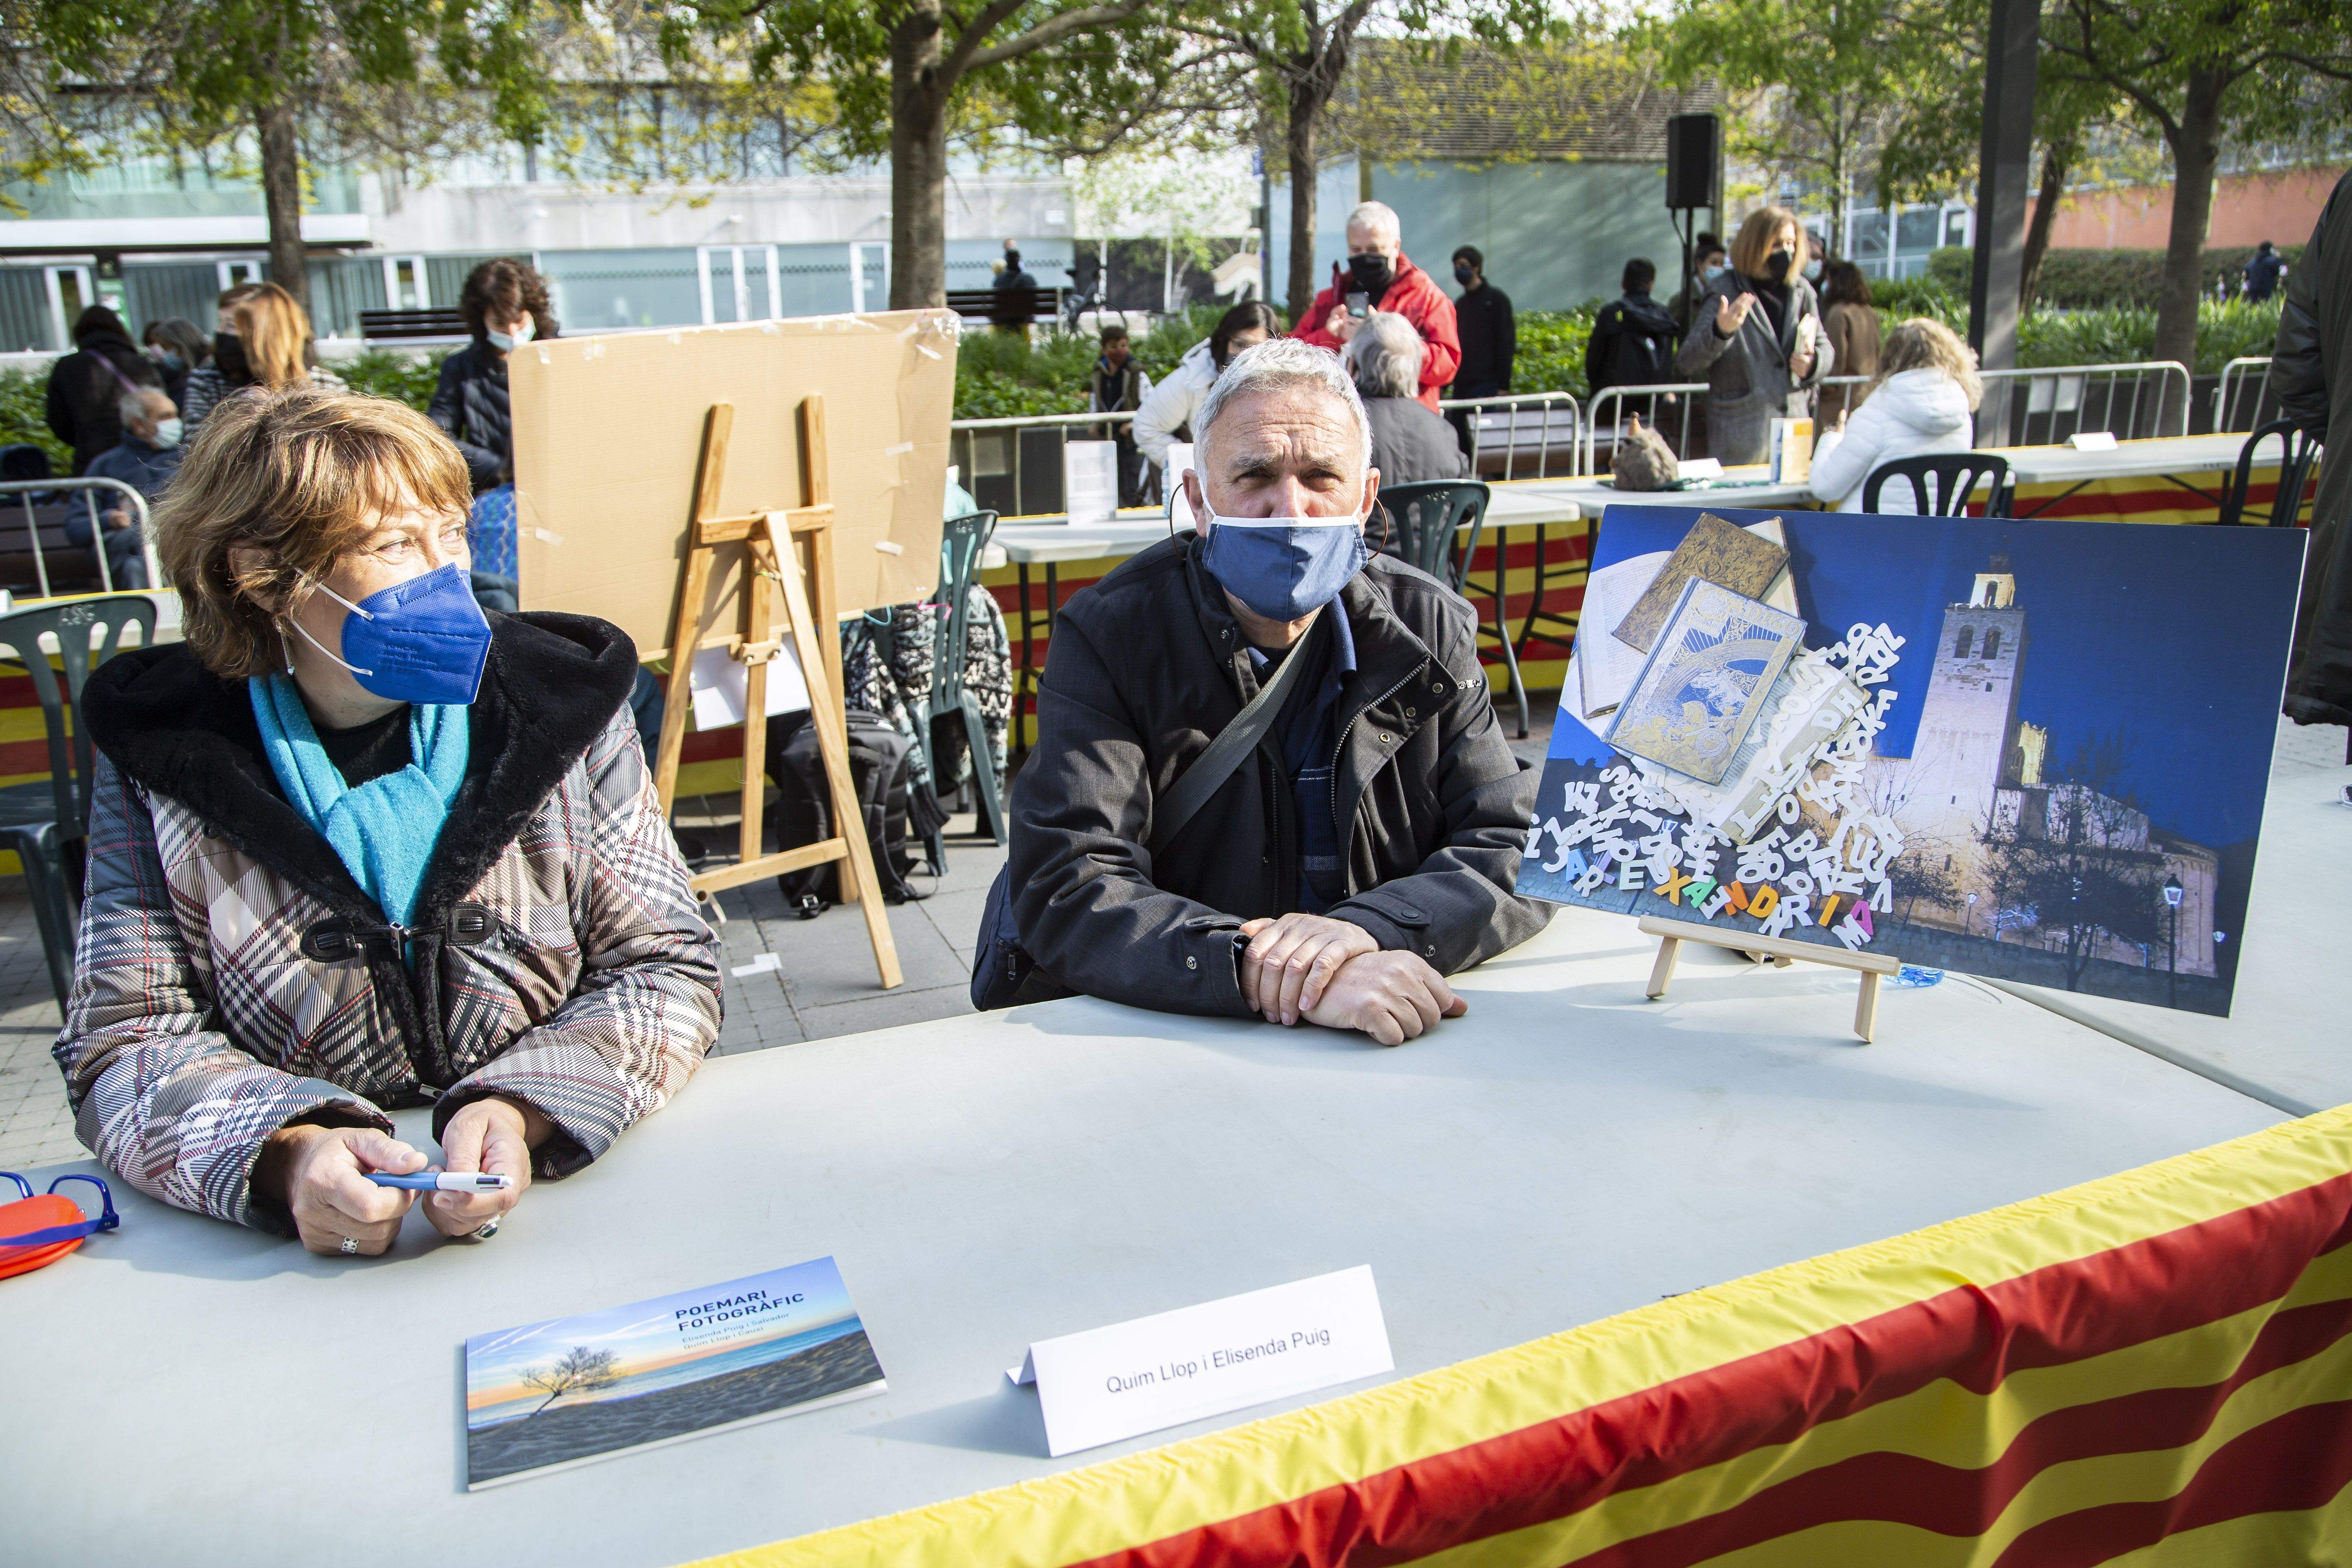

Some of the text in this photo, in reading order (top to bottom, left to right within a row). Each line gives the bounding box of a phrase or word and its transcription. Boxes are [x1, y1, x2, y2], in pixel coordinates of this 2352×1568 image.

[675, 1290, 766, 1319] POEMARI
[679, 1293, 804, 1331] FOTOGRÀFIC
[682, 1330, 721, 1343] Elisenda
[724, 1324, 744, 1333] Puig
[751, 1312, 790, 1325] Salvador
[684, 1339, 708, 1349] Quim
[711, 1334, 730, 1343] Llop
[1107, 1327, 1330, 1393] Quim Llop i Elisenda Puig
